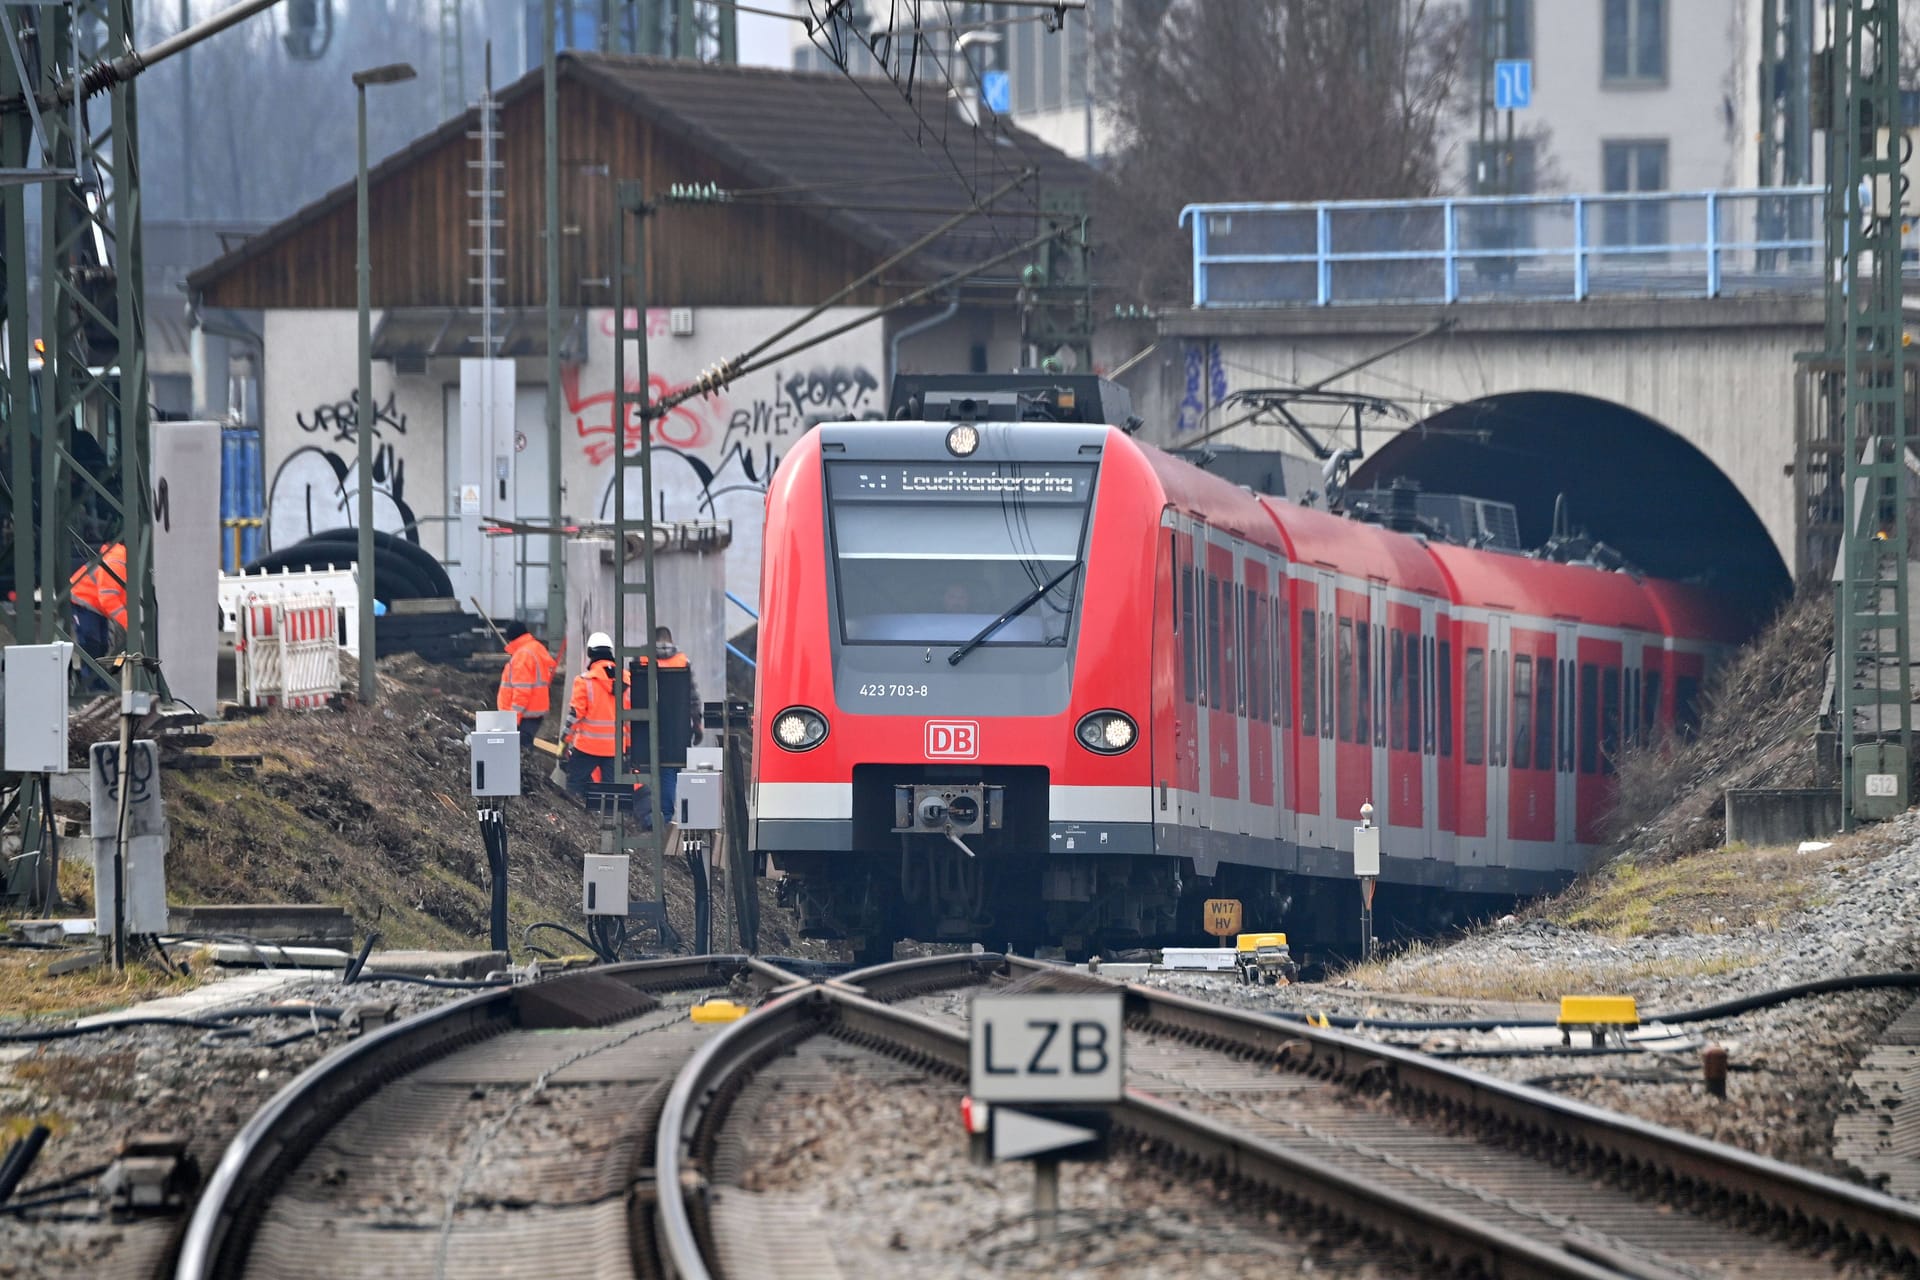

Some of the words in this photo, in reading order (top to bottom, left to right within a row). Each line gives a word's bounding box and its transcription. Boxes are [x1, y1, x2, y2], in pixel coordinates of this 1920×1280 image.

[860, 685, 885, 696] 423
[889, 685, 928, 696] 703-8
[933, 728, 971, 752] DB
[1871, 777, 1893, 792] 512
[1211, 903, 1234, 913] W17
[1215, 918, 1231, 928] HV
[984, 1021, 1108, 1075] LZB
